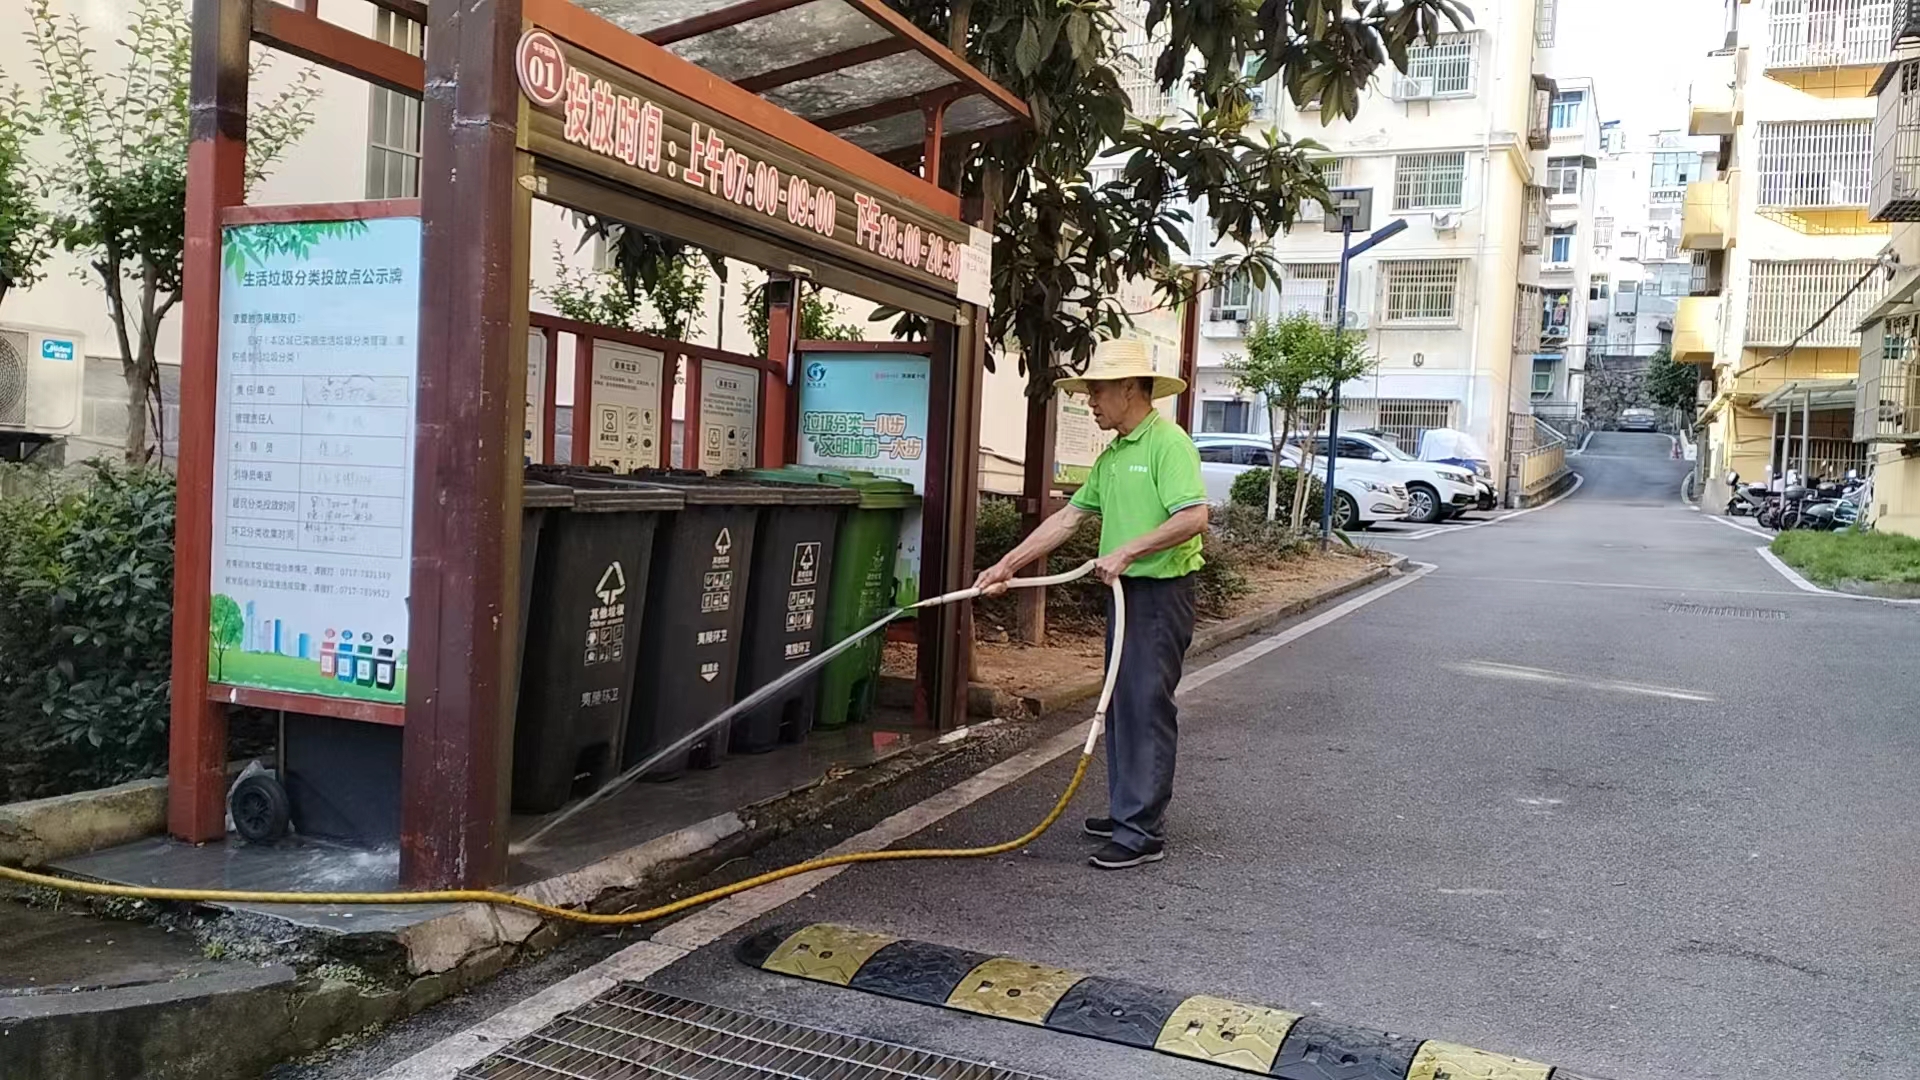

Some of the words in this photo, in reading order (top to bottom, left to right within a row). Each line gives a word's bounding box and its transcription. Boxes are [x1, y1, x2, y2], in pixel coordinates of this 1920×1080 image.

[529, 56, 556, 94] 01
[243, 268, 403, 287] 生活垃圾分类投放点公示牌
[804, 411, 906, 437] 垃圾分类一小步
[819, 437, 923, 460] 文明城市一大步
[589, 603, 625, 621] 其他垃圾
[697, 629, 728, 645] 夷陵环卫
[784, 641, 811, 656] 夷陵环卫
[580, 687, 619, 708] 夷陵环卫
